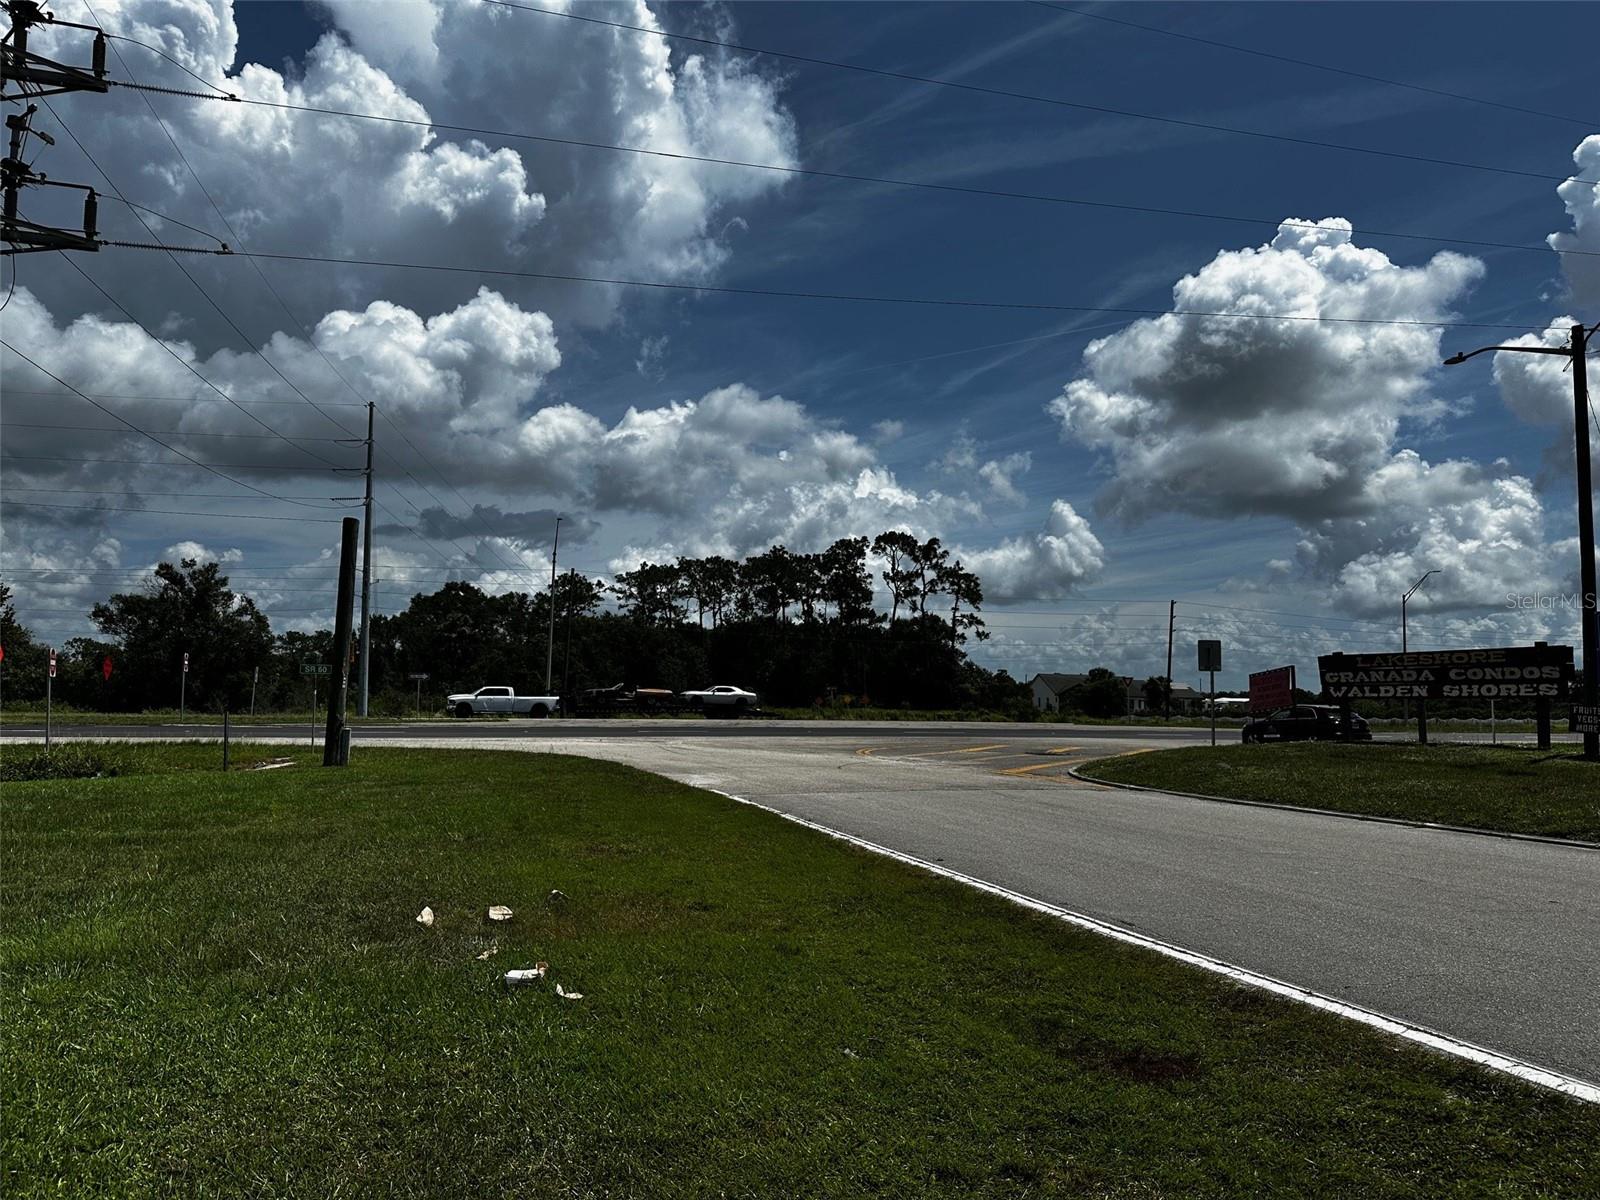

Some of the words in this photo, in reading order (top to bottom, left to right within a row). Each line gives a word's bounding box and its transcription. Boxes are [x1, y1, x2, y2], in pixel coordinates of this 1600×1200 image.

[1356, 651, 1507, 667] LAKESHORE
[304, 665, 316, 673] SR
[1325, 669, 1436, 683] GRANADA
[1448, 667, 1561, 681] CONDOS
[1329, 685, 1429, 698] WALDEN
[1442, 683, 1559, 697] SHORES
